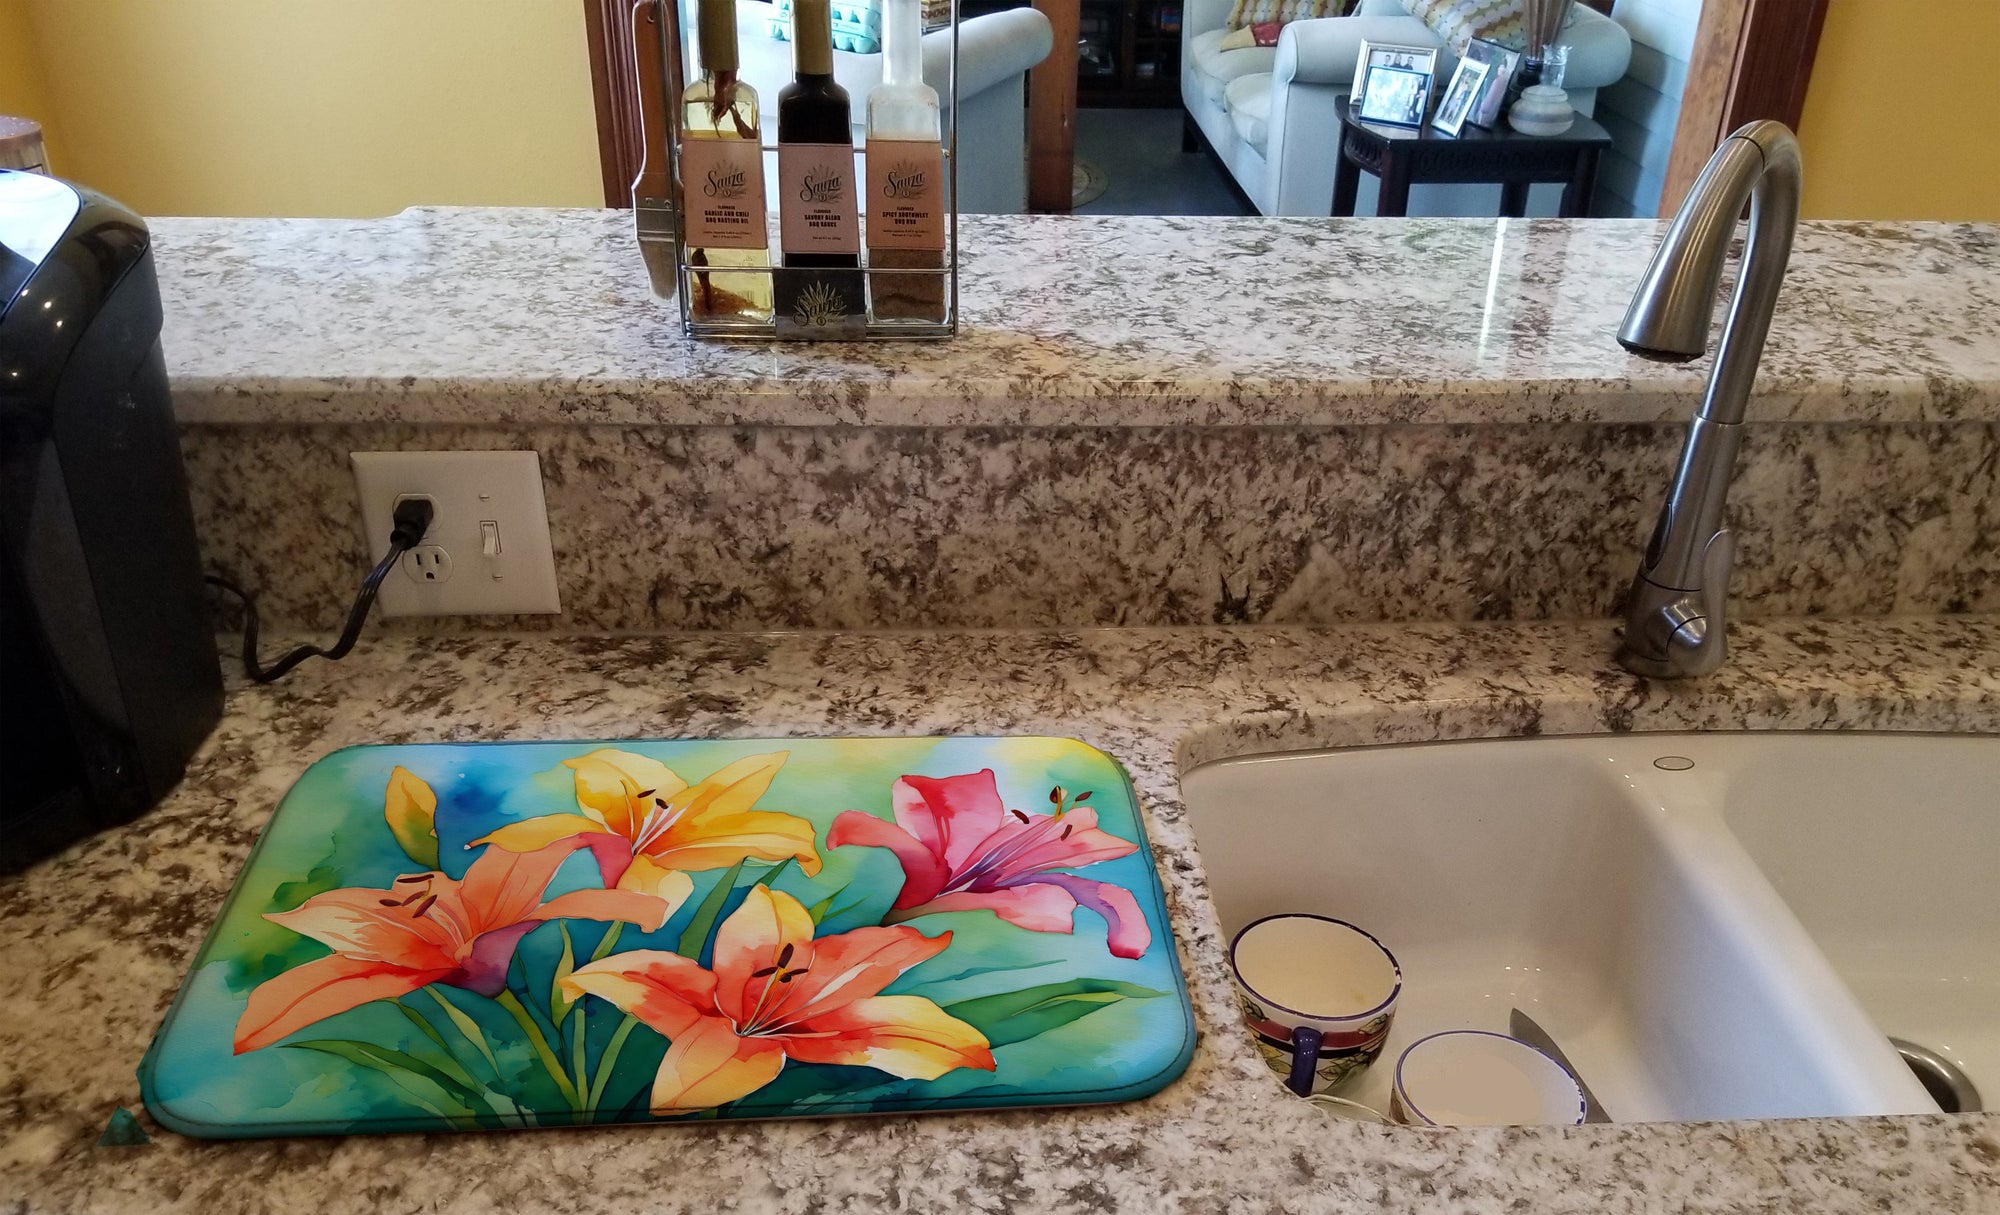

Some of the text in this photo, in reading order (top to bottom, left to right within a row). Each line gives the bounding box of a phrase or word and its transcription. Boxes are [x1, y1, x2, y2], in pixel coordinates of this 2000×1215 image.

[703, 169, 746, 197] Sauza
[800, 175, 842, 202] Sauza
[883, 170, 925, 198] Sauza
